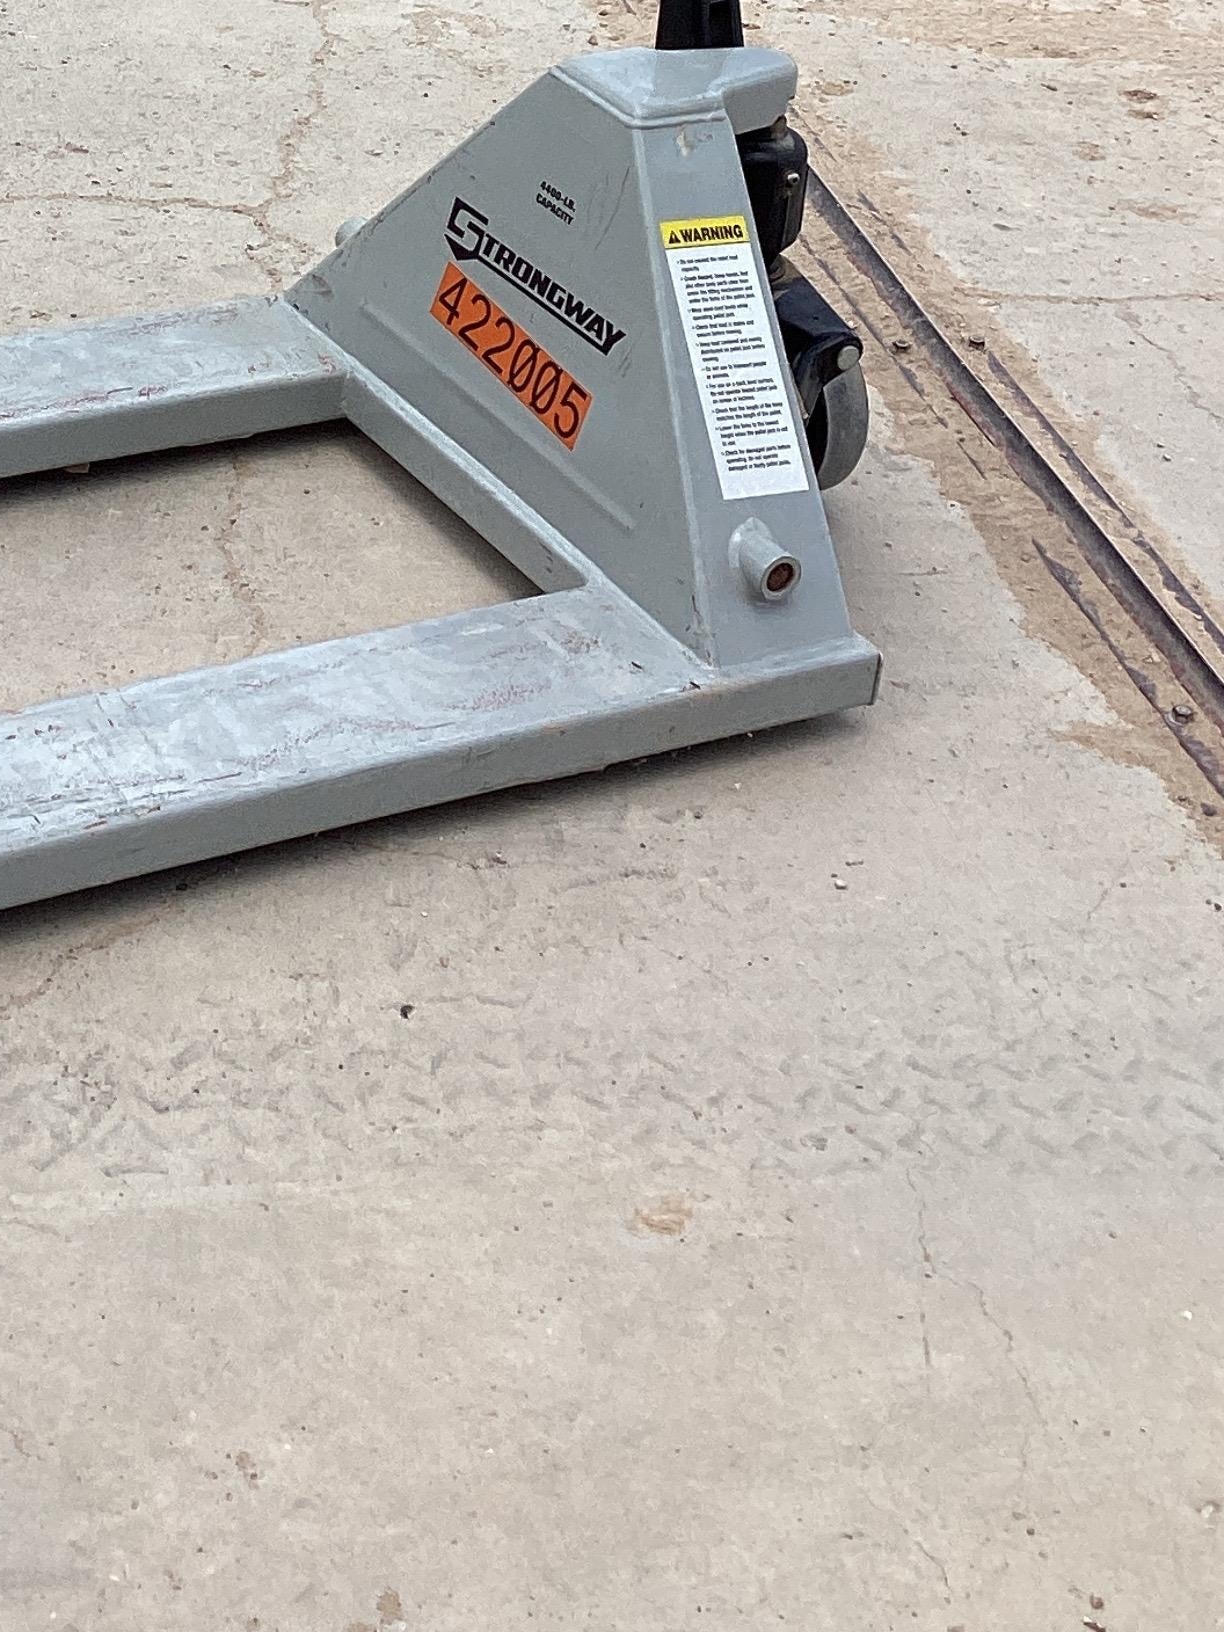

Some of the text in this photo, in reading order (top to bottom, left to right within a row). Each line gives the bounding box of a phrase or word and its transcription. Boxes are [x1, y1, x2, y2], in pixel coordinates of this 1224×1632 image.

[536, 192, 575, 225] CAPACITY
[679, 224, 744, 243] WARNING
[444, 197, 626, 356] STRONGWAY
